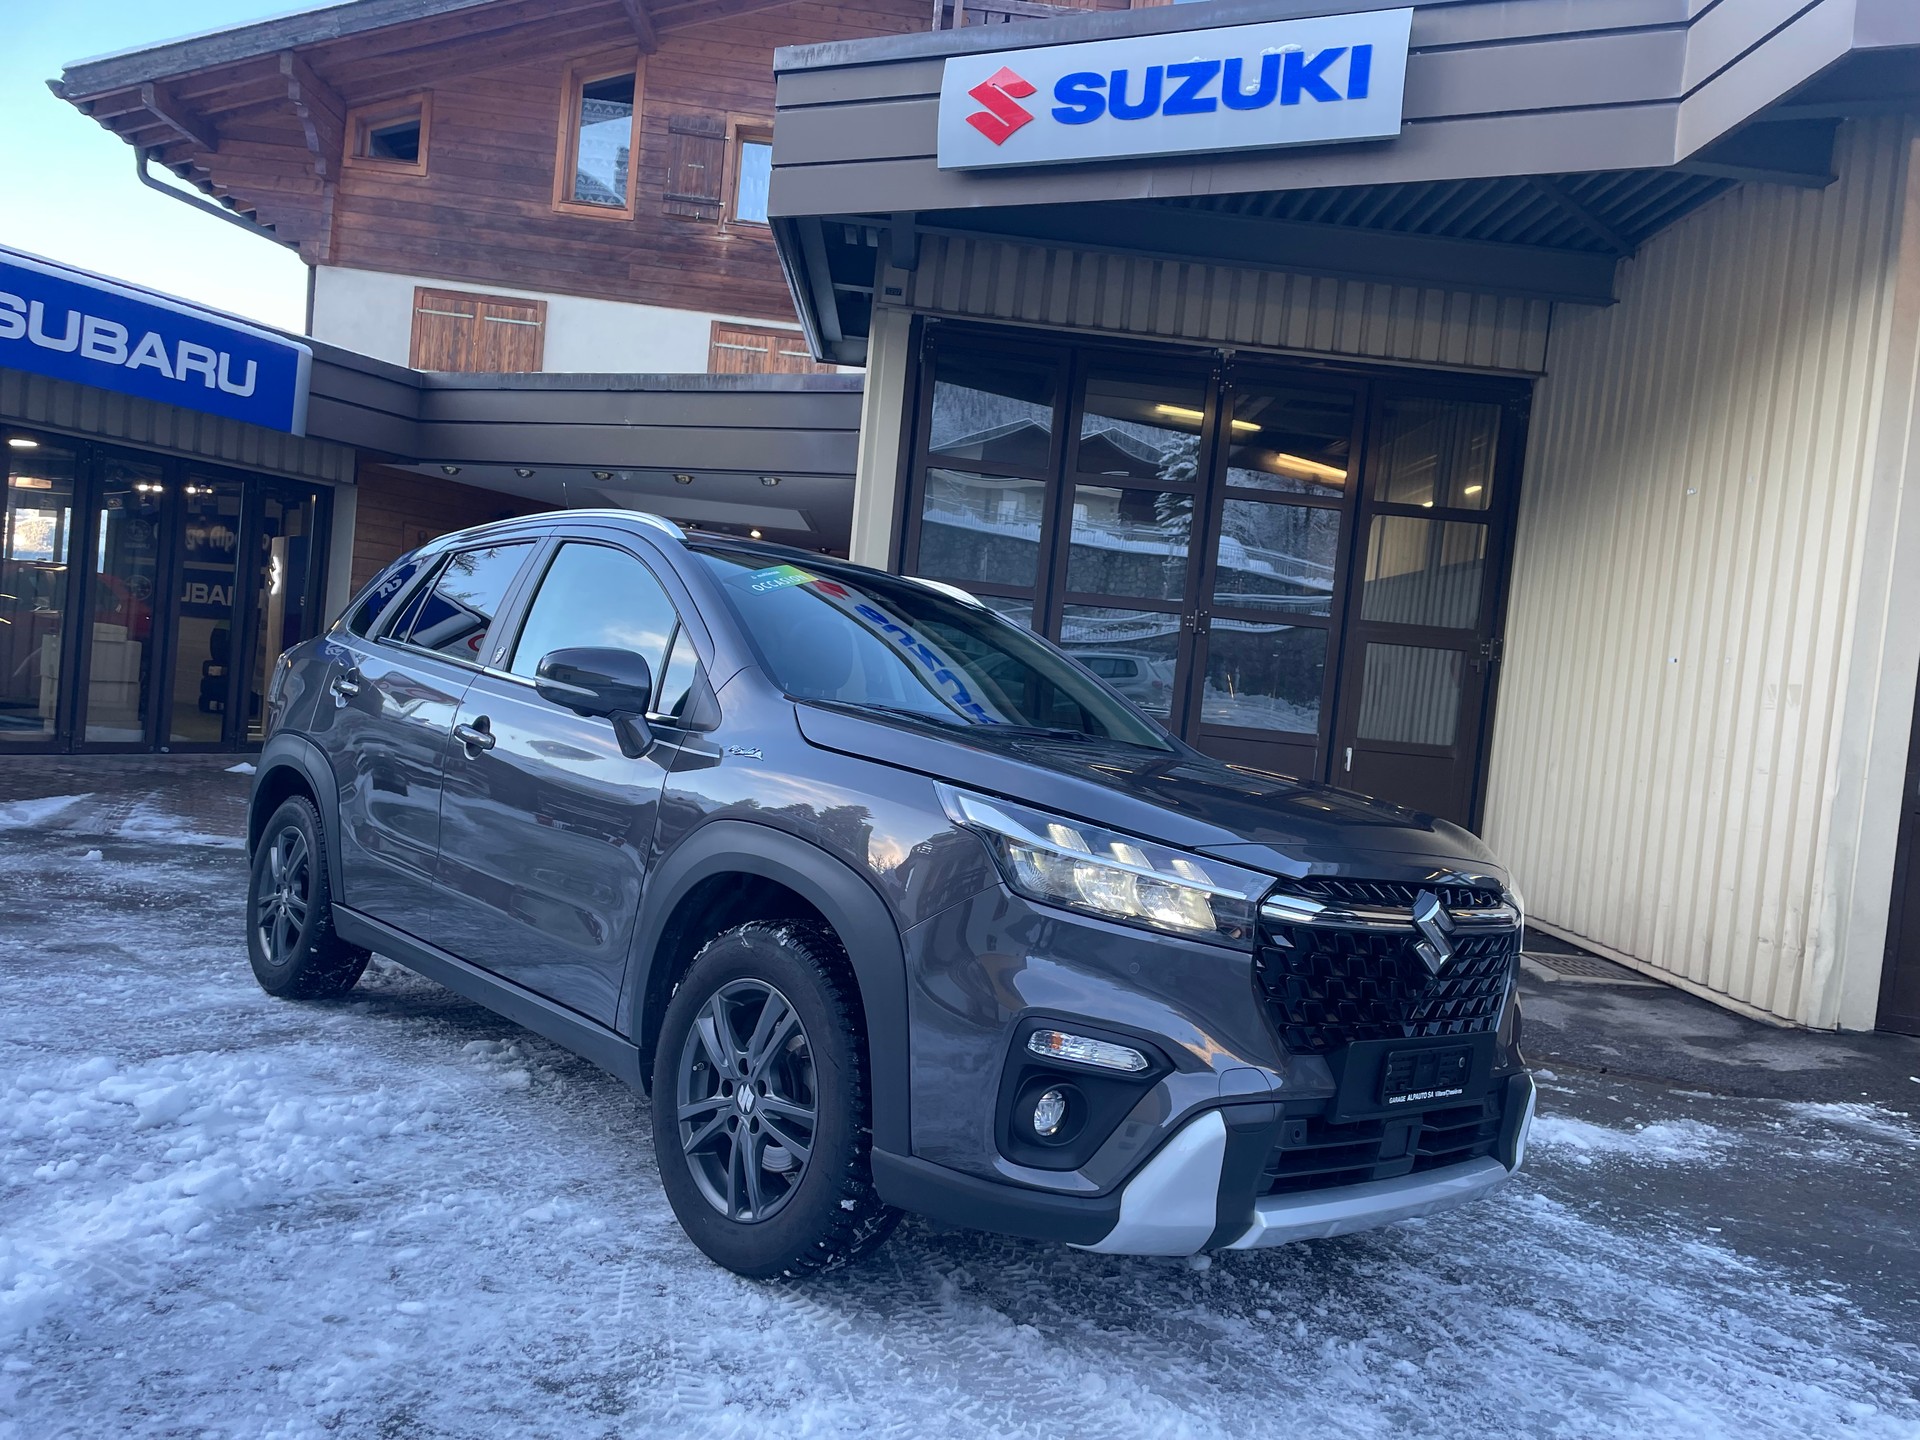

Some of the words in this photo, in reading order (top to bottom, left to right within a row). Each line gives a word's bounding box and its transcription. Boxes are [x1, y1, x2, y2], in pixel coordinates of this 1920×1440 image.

[1051, 43, 1373, 126] SUZUKI
[0, 290, 258, 397] SUBARU
[751, 574, 808, 592] OCCASION
[1389, 1096, 1406, 1104] GARAGE
[1407, 1092, 1427, 1102] ALPAUTO
